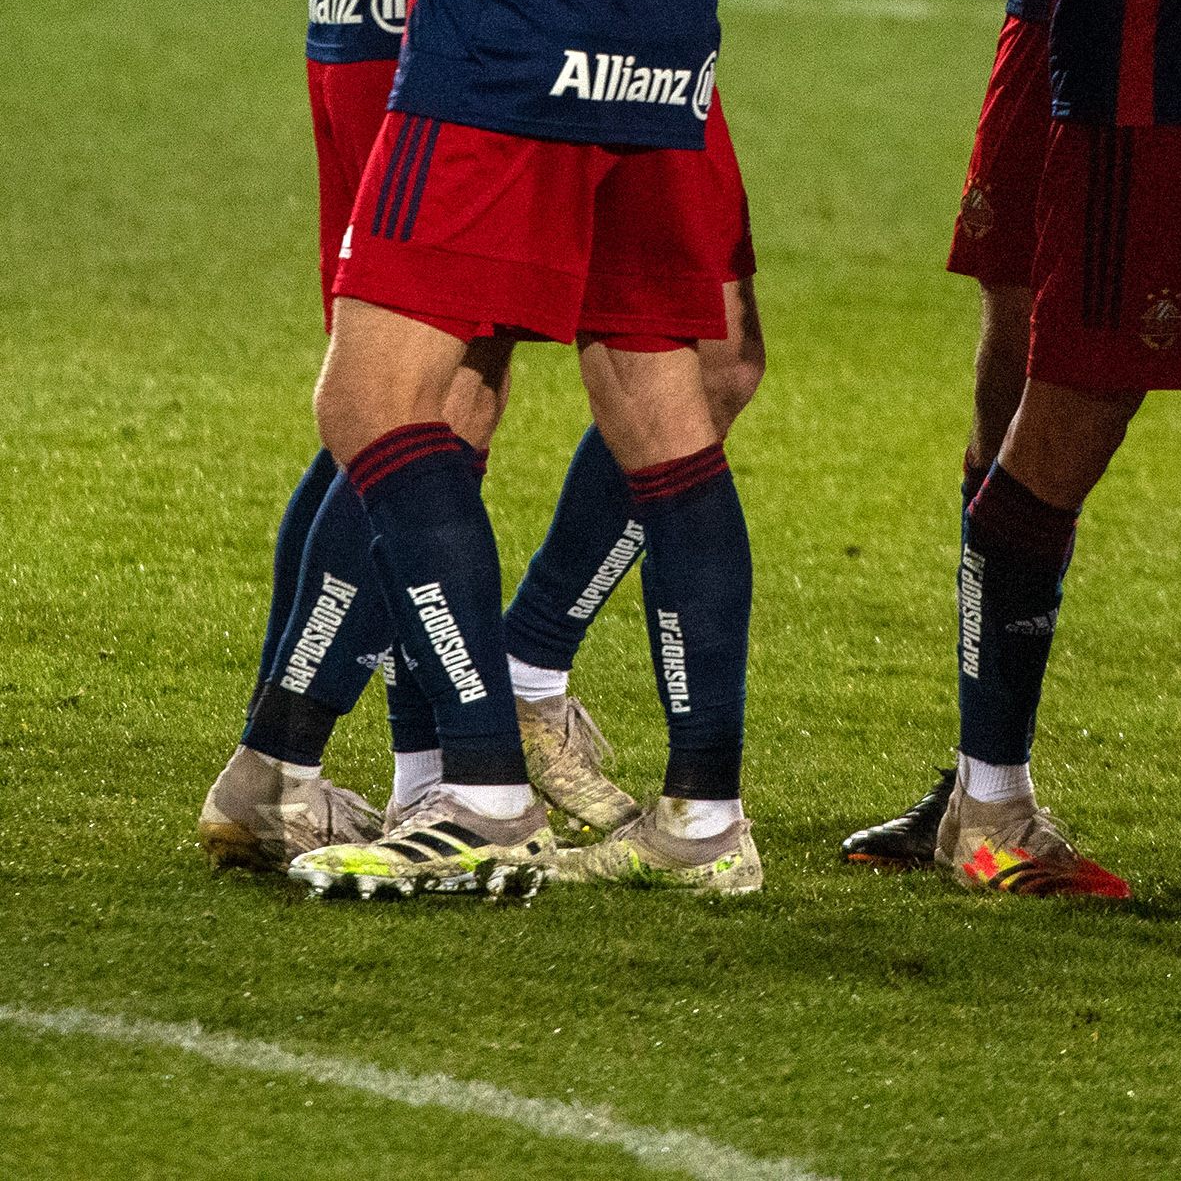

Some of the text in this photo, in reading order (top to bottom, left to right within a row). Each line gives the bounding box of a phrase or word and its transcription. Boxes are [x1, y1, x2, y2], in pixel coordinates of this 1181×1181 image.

[549, 49, 692, 106] Allianz
[567, 519, 645, 619] RAPIDSHOP.AT
[280, 571, 358, 694] RAPIDSHOP.AT
[406, 582, 488, 704] RAPIDSHOP.AT
